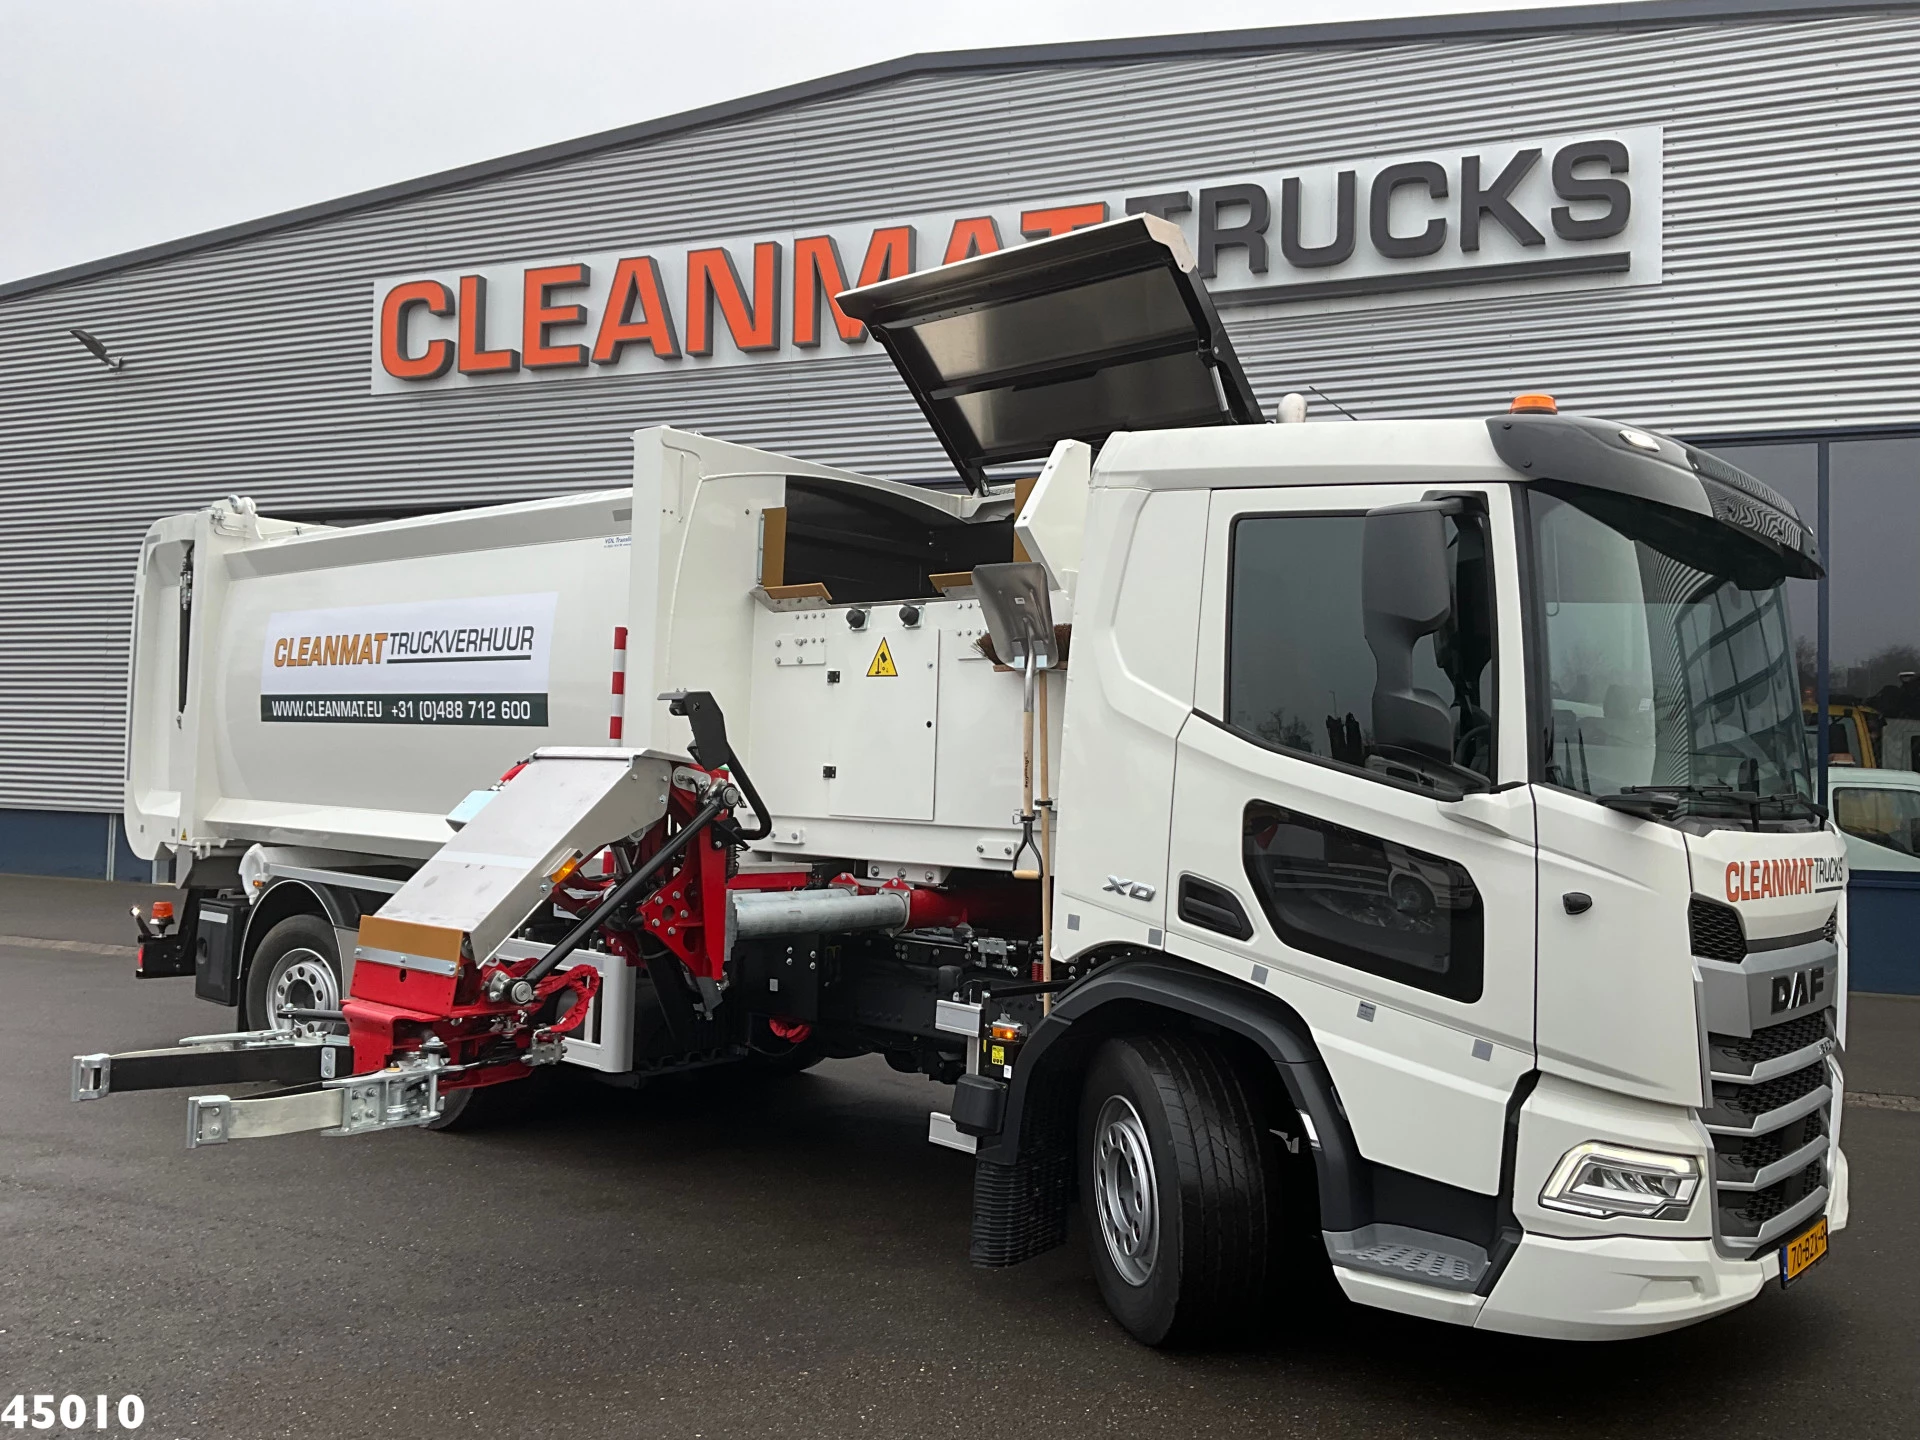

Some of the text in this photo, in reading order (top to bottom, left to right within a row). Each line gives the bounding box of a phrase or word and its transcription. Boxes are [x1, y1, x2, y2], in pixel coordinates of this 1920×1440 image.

[273, 625, 535, 668] CLEANMAT TRUCKVERHUUR
[271, 700, 532, 722] WWW.CLEANMAT.EU +31 (0)488 712 600
[1725, 856, 1844, 903] CLEANMAT TRUCKS
[1770, 966, 1825, 1016] DAF
